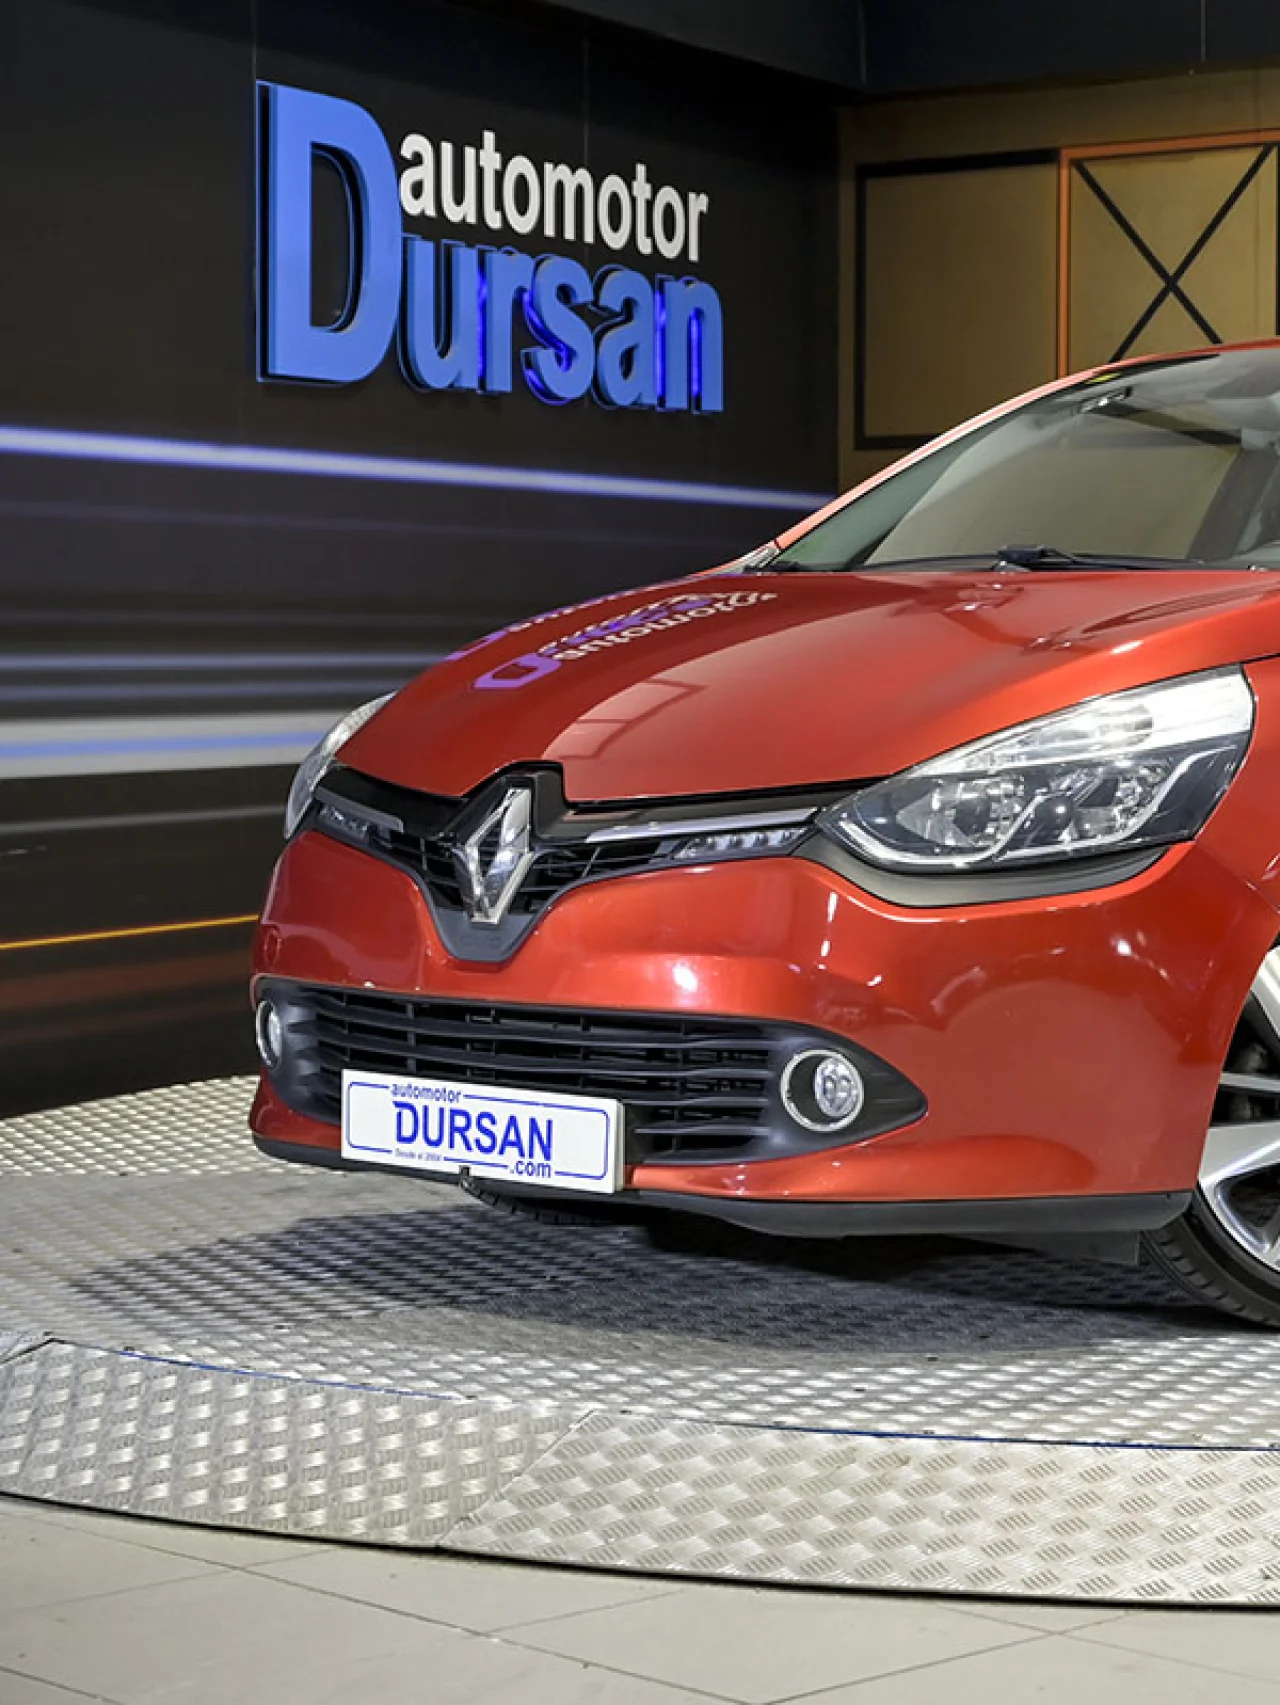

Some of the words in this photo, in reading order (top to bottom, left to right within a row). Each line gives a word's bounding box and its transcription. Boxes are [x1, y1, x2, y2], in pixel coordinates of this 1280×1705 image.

[400, 129, 709, 262] automotor
[256, 79, 725, 414] Dursan
[391, 1083, 462, 1104] automotor
[392, 1100, 553, 1162] DURSAN
[509, 1160, 552, 1179] .com
